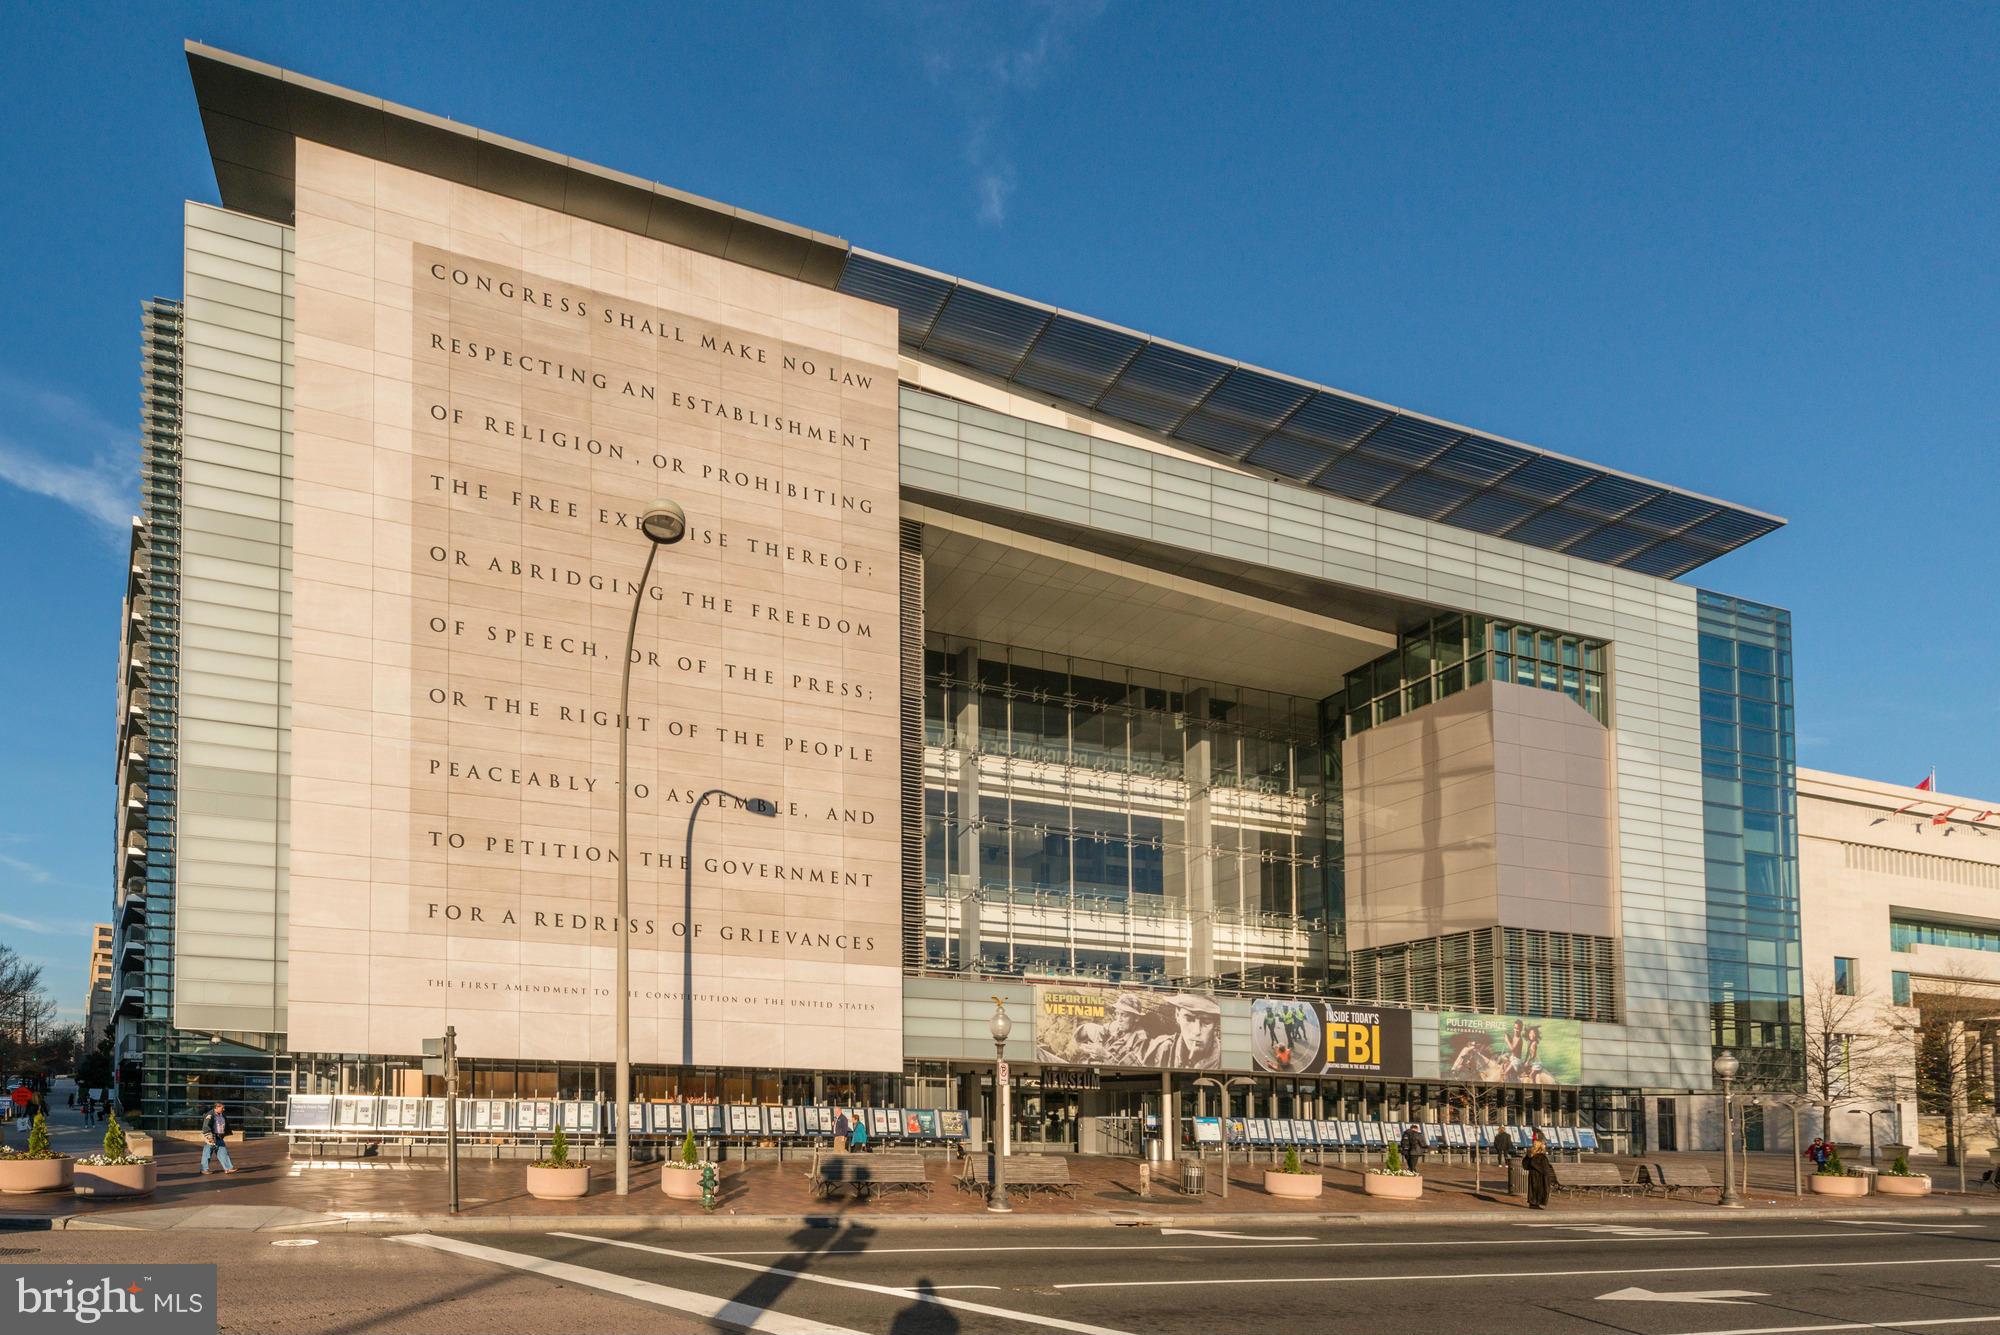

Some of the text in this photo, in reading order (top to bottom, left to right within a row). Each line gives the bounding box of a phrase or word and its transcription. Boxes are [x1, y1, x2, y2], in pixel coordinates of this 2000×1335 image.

[430, 263, 873, 390] CONGRESS SHALL MAKE NO LAW
[430, 332, 871, 452] RESPECTING AN ESTABLISHMENT
[430, 403, 463, 425] OF
[652, 453, 685, 474] OR
[702, 464, 873, 514] PROHIBITING
[429, 474, 872, 577] THE FREE EXEISE THEREOF;
[429, 545, 873, 639] OR ABRIDGING THE FREEDOM
[429, 617, 873, 701] OF SPEECH, OR OF THE PRESS;
[429, 687, 873, 763] OR THE RIGHT OF THE PEOPLE
[429, 759, 875, 825] PEACEABLY O ASSEMBLE, AND
[427, 829, 873, 888] TO PETITION THE GOVERNMENT
[427, 903, 485, 923] FOR
[501, 909, 517, 925] A
[671, 921, 703, 940] OF
[719, 925, 874, 951] GRIEVANCES
[426, 979, 453, 988] THE
[460, 981, 499, 990] FIRST
[504, 984, 587, 995] AMENDMENT
[645, 991, 739, 1003] CONSTITUTION
[743, 997, 758, 1005] OF
[763, 998, 786, 1006] THE
[790, 1000, 833, 1008] UNITED
[838, 1002, 875, 1011] STATES
[1045, 993, 1104, 1005] REPORTING
[1326, 1010, 1380, 1025] INSIDE TODAY'S
[1446, 1017, 1507, 1030] PULITZER PRIZE
[1326, 1023, 1380, 1065] FBI
[1043, 1071, 1100, 1089] NEWSEUM
